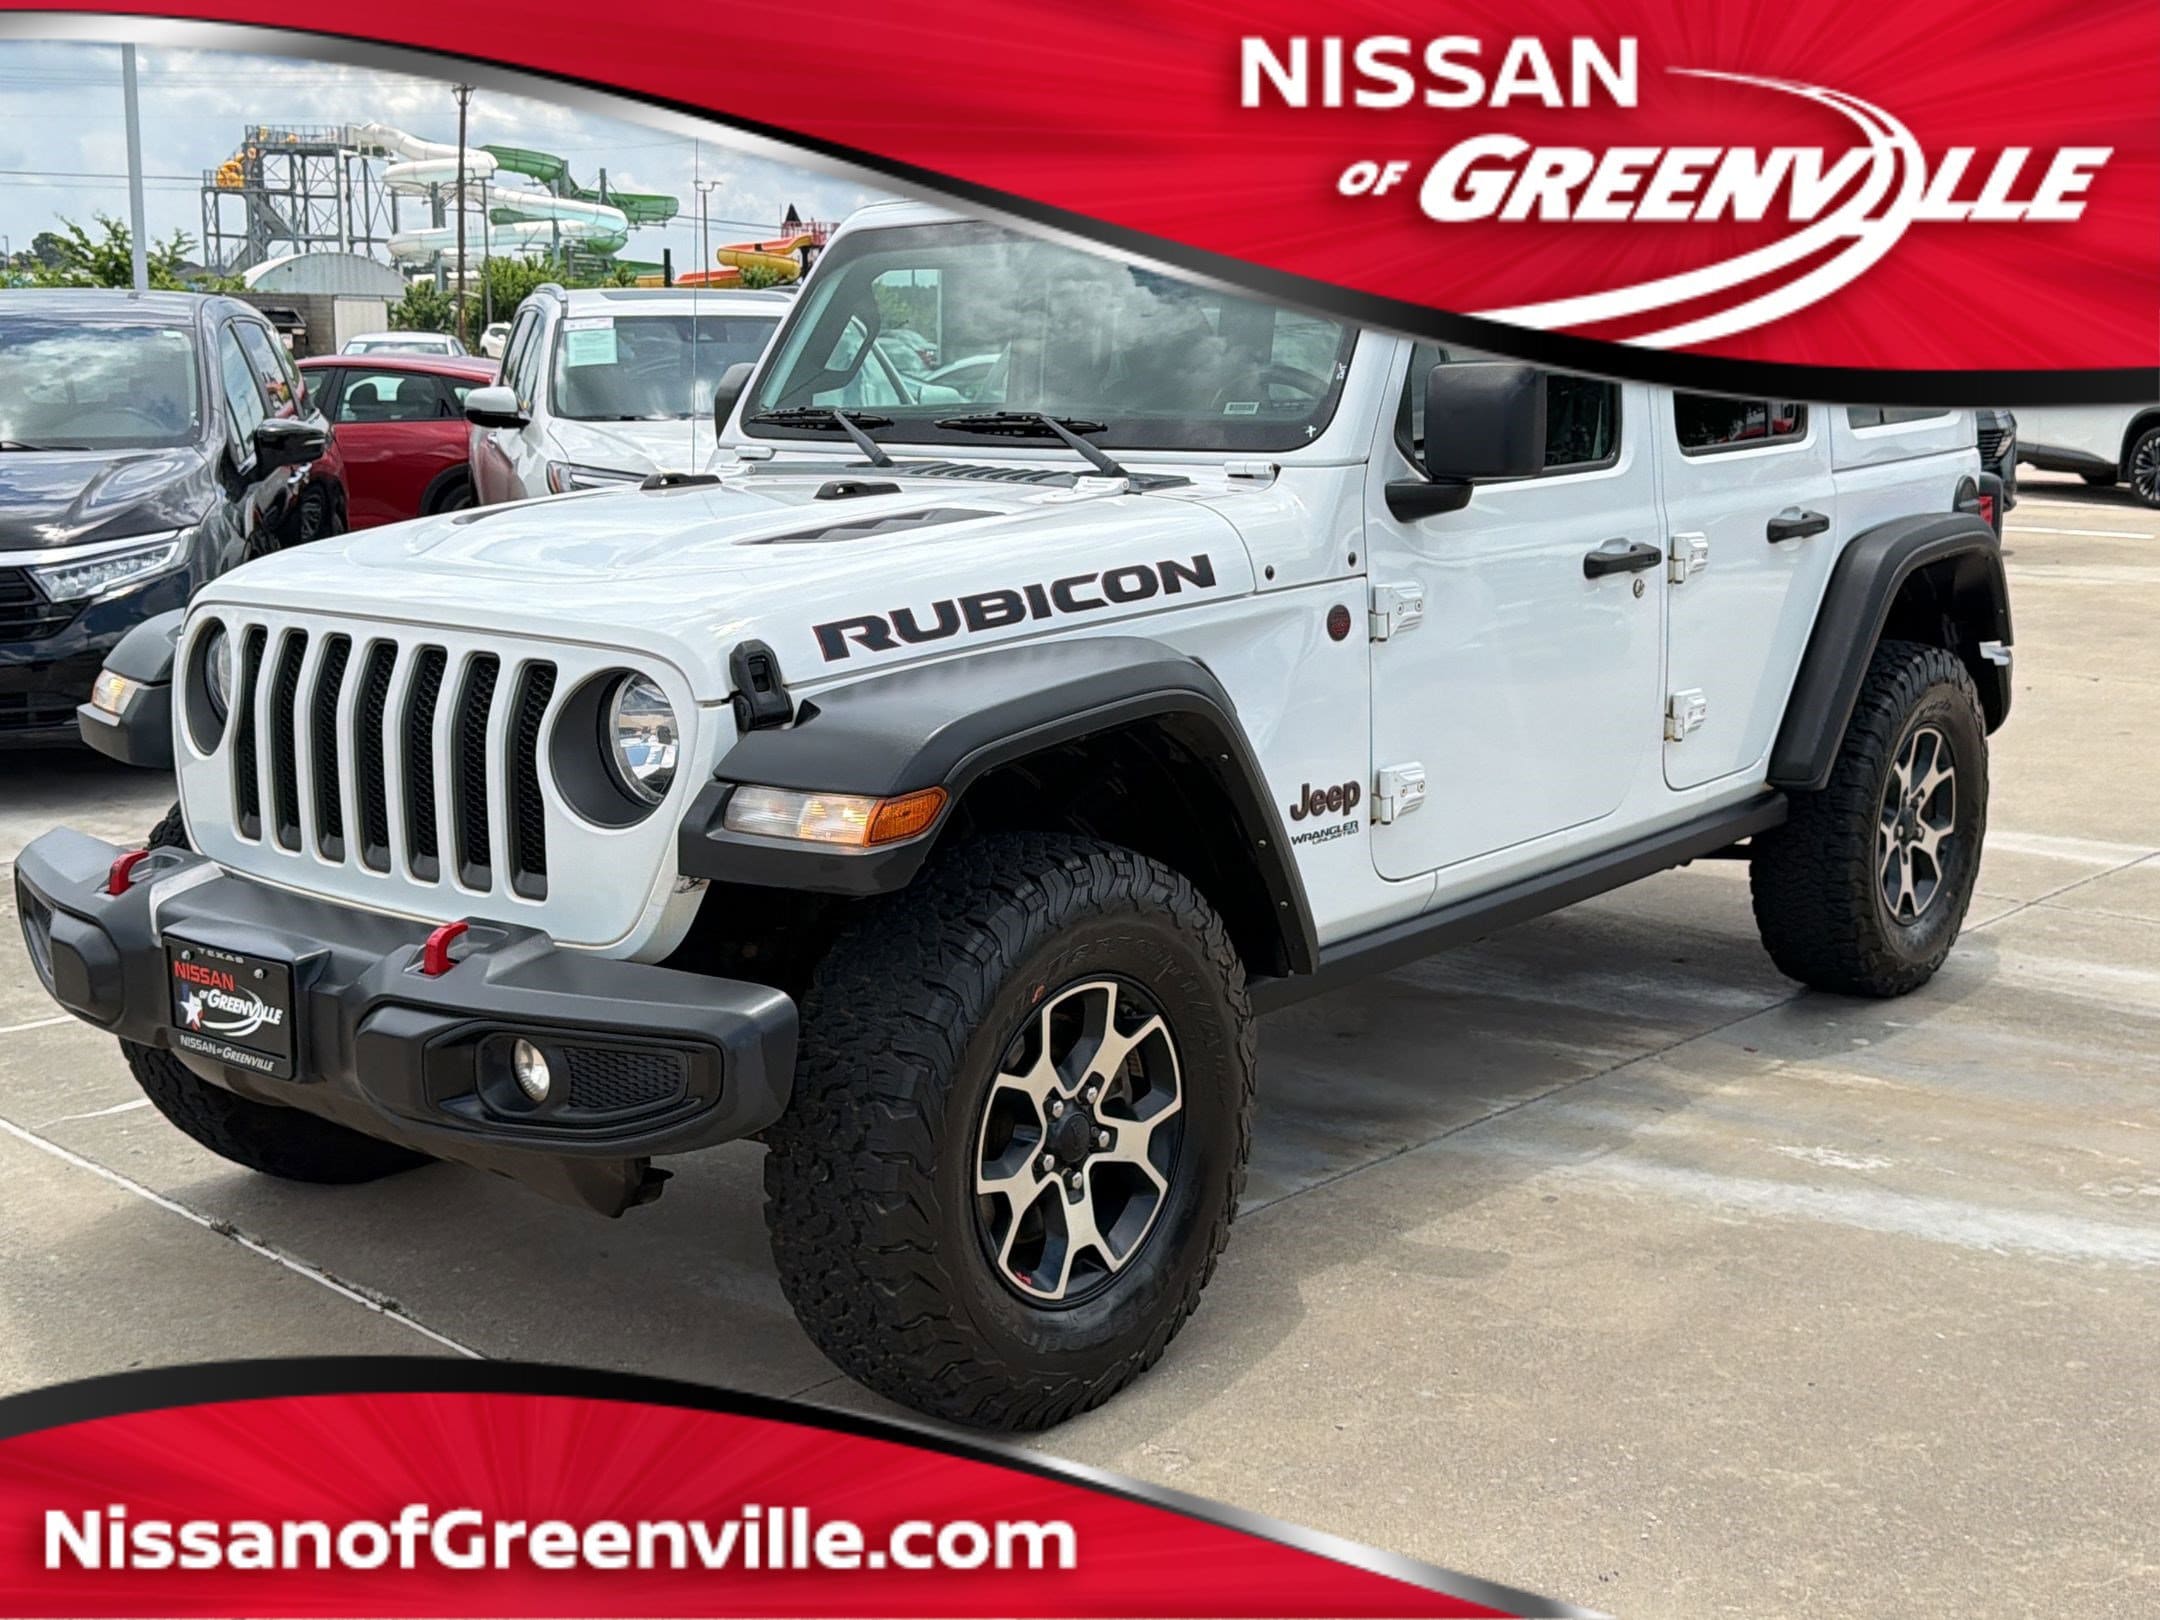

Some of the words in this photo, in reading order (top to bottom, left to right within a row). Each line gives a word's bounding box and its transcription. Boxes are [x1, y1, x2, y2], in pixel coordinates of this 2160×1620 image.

[812, 554, 1217, 662] RUBICON
[1290, 781, 1361, 821] Jeep
[1291, 820, 1359, 845] WRANGLER
[198, 948, 244, 964] TEXAS
[173, 960, 235, 992] NISSAN
[208, 988, 283, 1025] GREENVILLE
[179, 1034, 217, 1055] NISSAN
[222, 1046, 275, 1072] GREENVILLE
